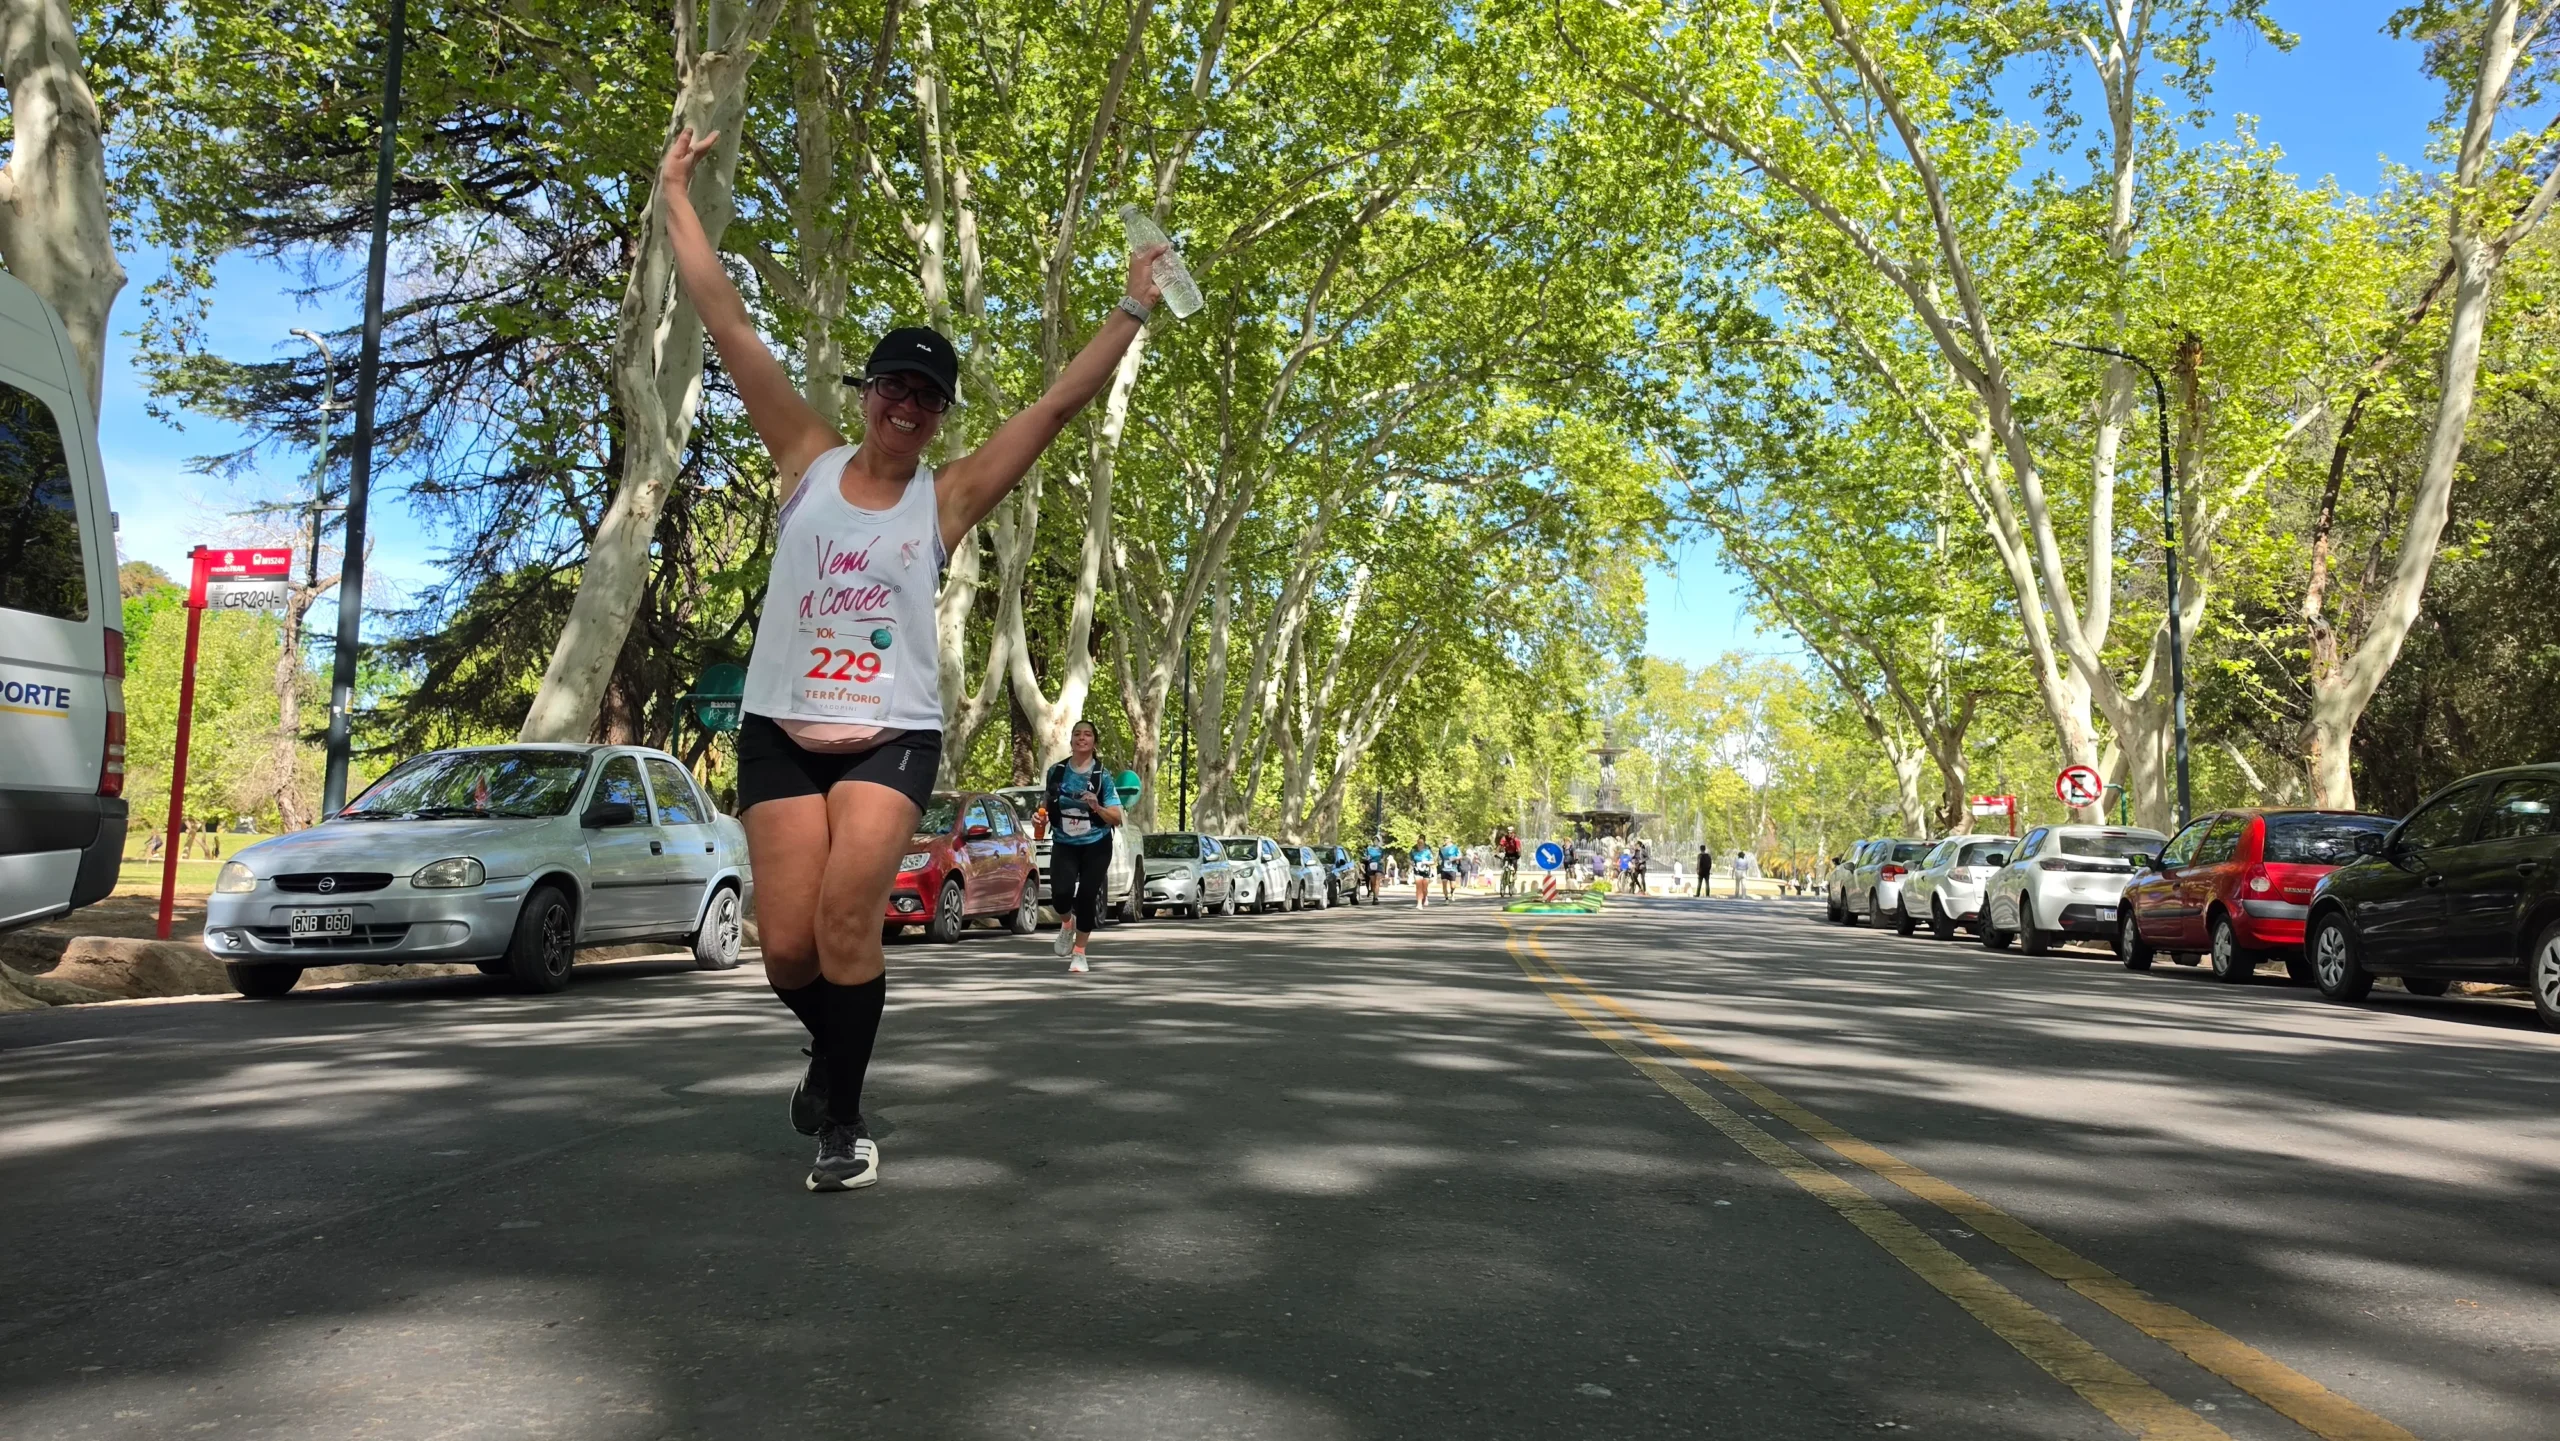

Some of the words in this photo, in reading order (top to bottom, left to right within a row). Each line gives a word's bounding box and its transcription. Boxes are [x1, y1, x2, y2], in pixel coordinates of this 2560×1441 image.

[916, 343, 932, 352] FILA
[816, 535, 880, 580] Vení
[799, 590, 814, 618] a
[816, 628, 836, 639] 10k
[803, 647, 881, 683] 229
[0, 680, 71, 709] ORTE
[898, 749, 912, 771] bloom
[293, 916, 318, 932] GNB
[325, 915, 350, 931] 860
